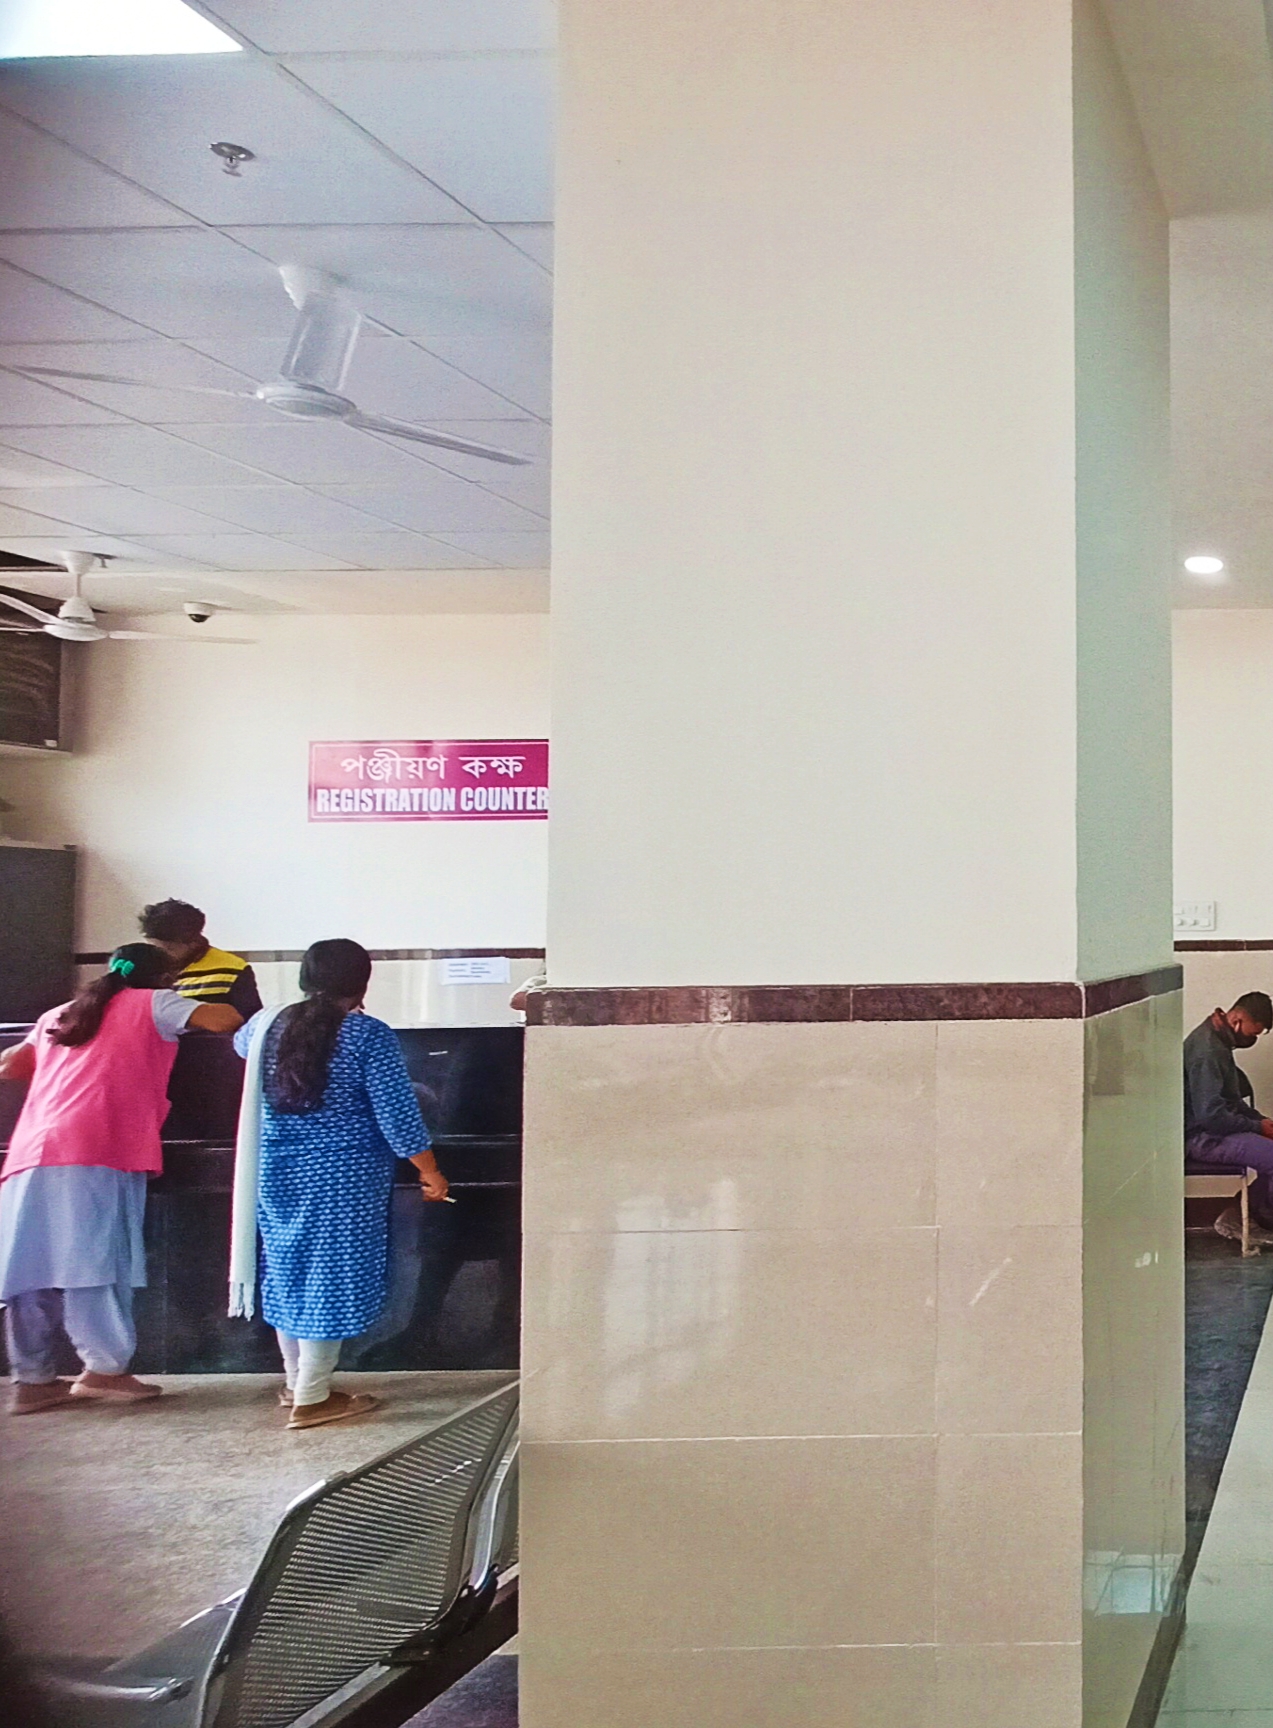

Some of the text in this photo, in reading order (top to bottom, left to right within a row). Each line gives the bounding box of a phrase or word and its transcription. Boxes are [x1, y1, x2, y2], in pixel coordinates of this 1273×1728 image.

[458, 756, 526, 779] কক্ষ
[316, 786, 549, 813] REGISTRATION COUNTER
